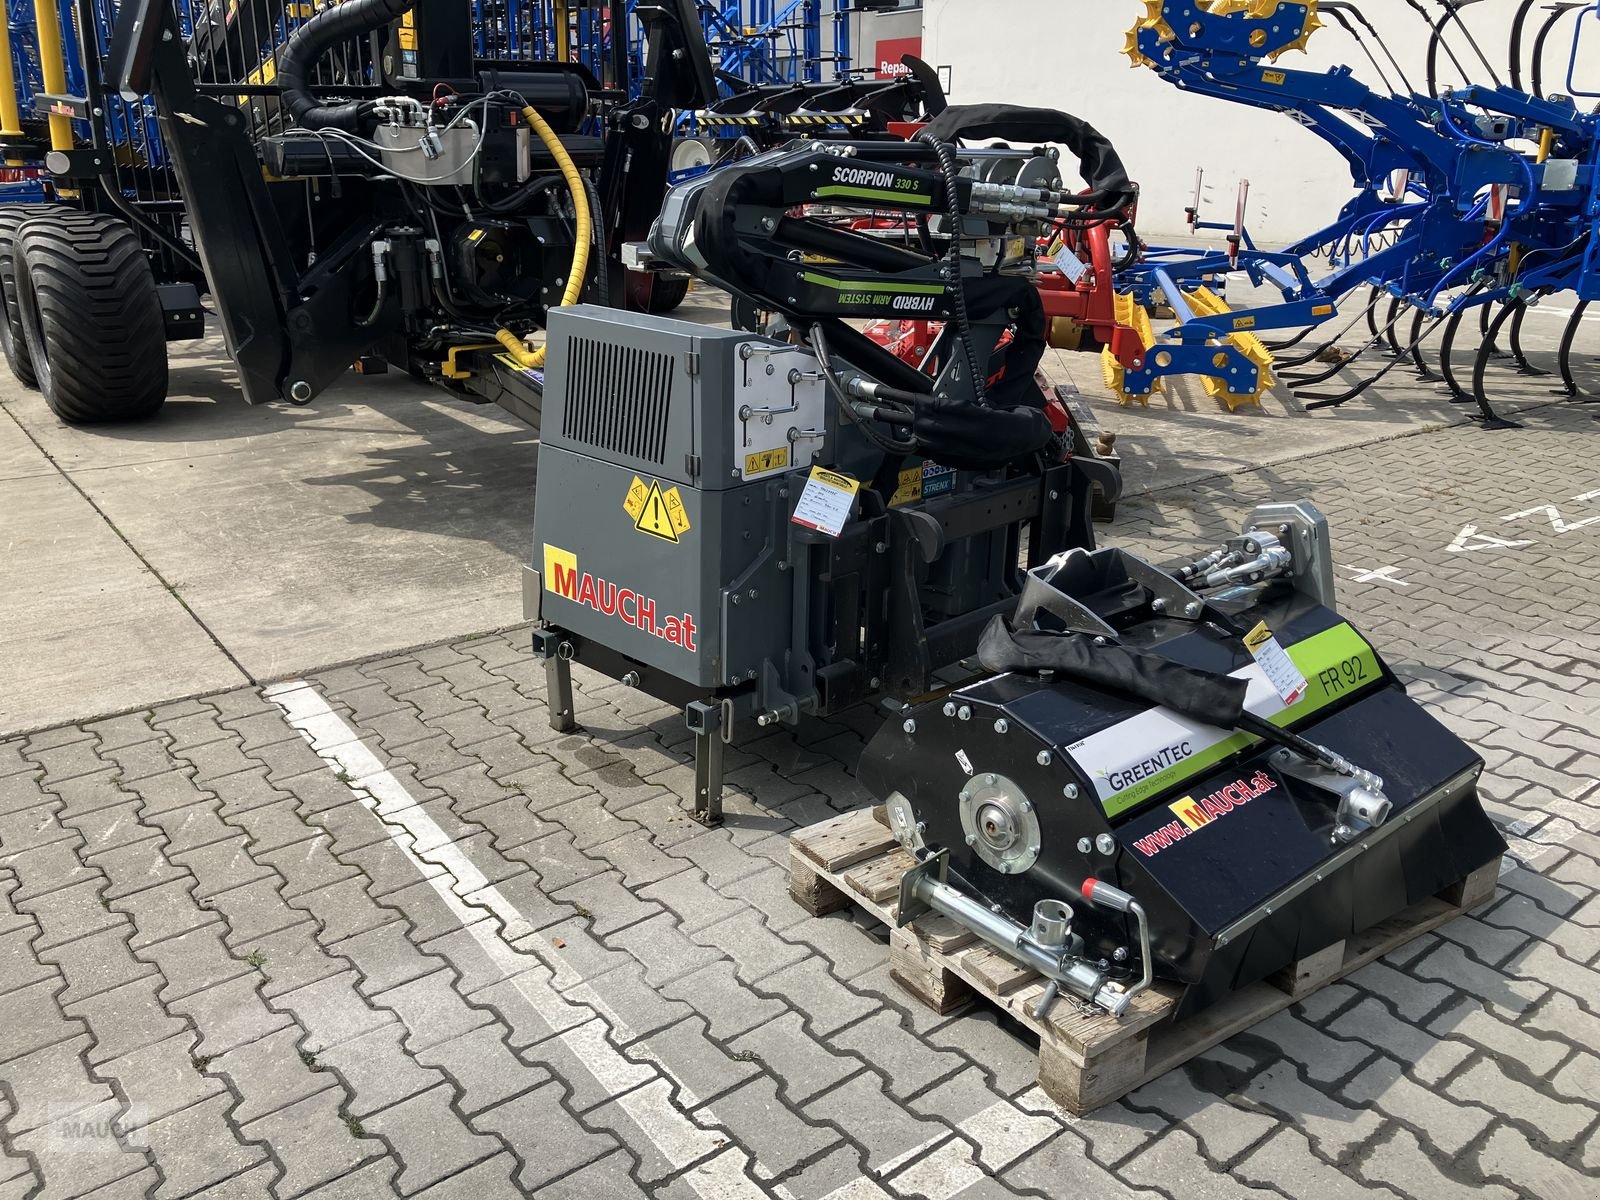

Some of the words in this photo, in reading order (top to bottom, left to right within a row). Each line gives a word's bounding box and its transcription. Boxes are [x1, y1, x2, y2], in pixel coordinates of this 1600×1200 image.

[832, 166, 894, 188] SCORPION
[895, 179, 912, 189] 330
[912, 180, 919, 190] S
[837, 294, 872, 305] SYSTEM
[872, 294, 892, 305] ARM
[892, 295, 935, 311] HYBRID
[923, 480, 949, 494] STRENX
[553, 561, 697, 653] MAUCH.at
[1318, 666, 1345, 697] FR
[1341, 655, 1368, 685] 92
[1132, 769, 1278, 858] www.MAUCH.at
